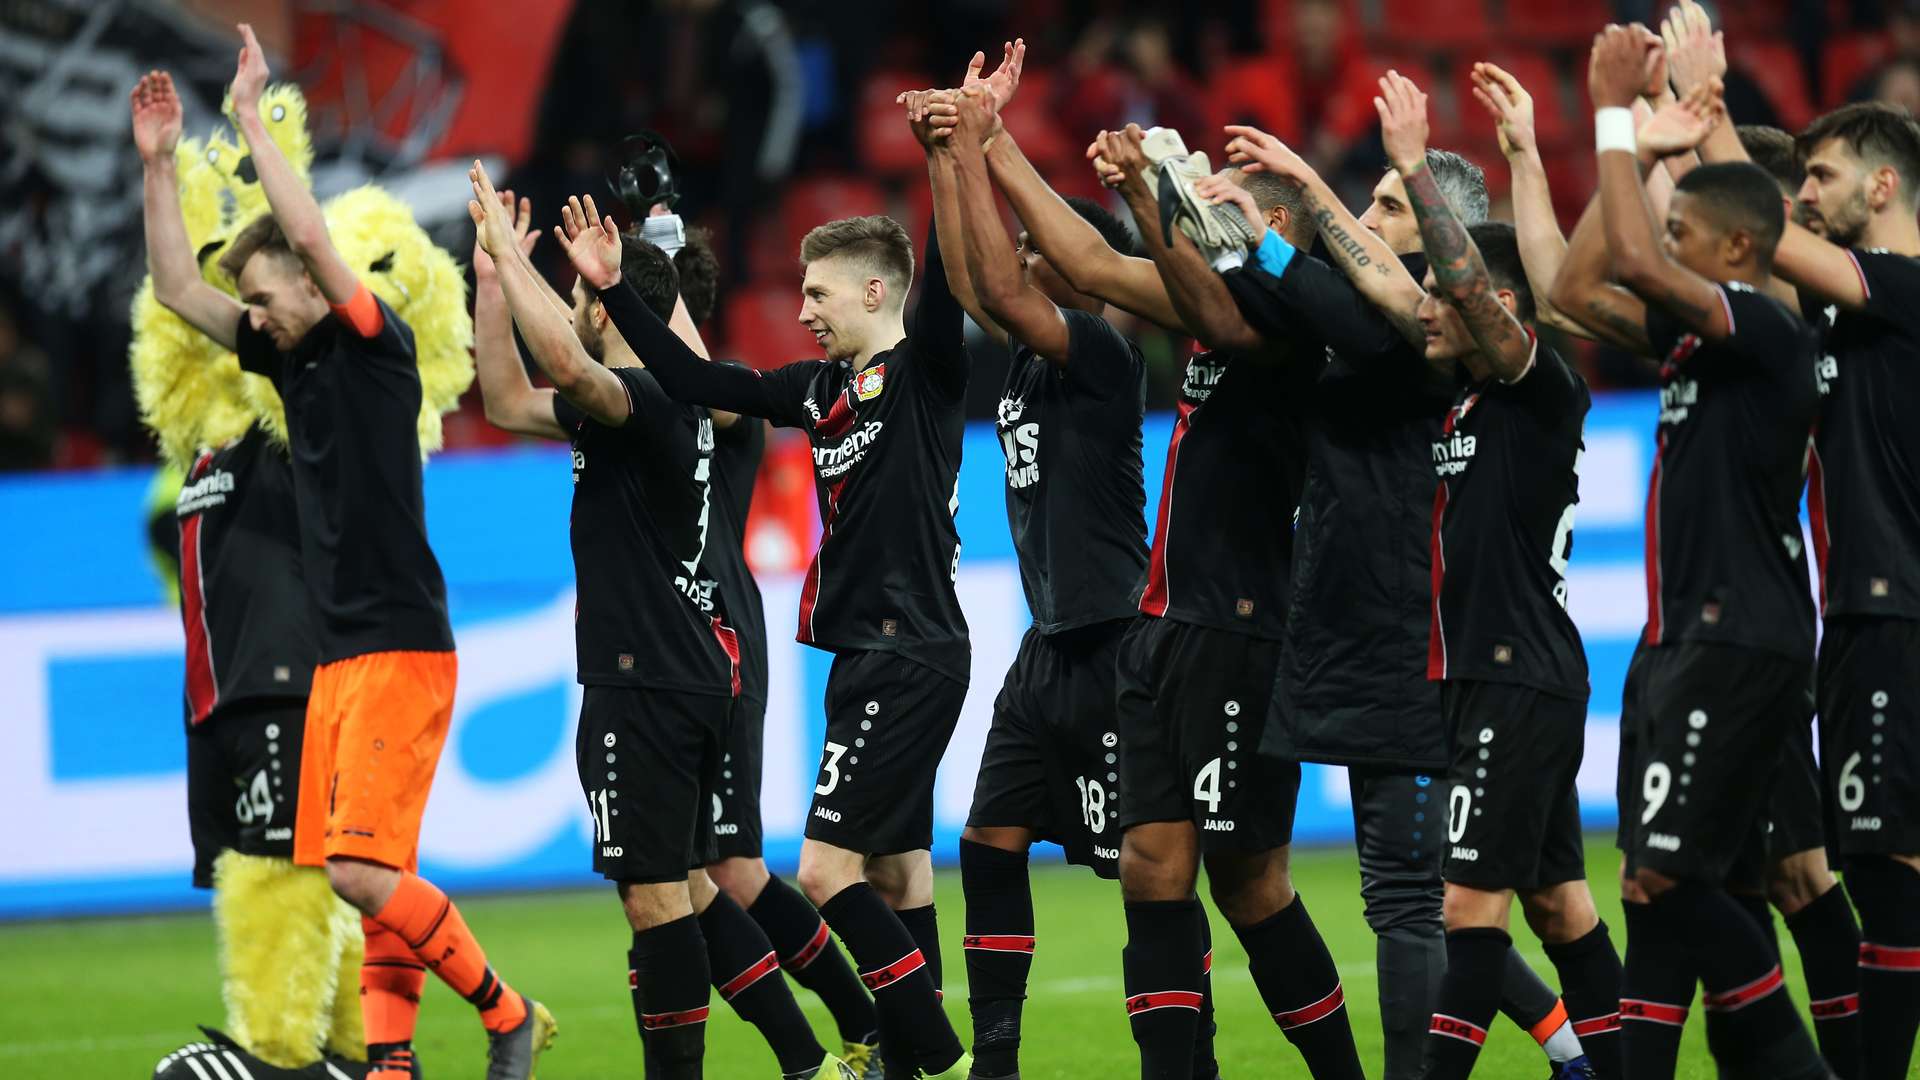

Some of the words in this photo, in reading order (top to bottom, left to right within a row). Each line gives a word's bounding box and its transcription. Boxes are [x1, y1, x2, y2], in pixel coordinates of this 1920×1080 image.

[1317, 207, 1371, 267] Renato
[1075, 775, 1106, 834] 18
[1193, 757, 1221, 813] 4
[1641, 762, 1671, 825] 9
[1839, 752, 1865, 811] 6
[814, 806, 842, 823] JAKO
[1203, 819, 1234, 832] JAKO
[1449, 785, 1472, 843] 0
[1094, 844, 1120, 860] JAKO
[1451, 846, 1479, 861] JAKO
